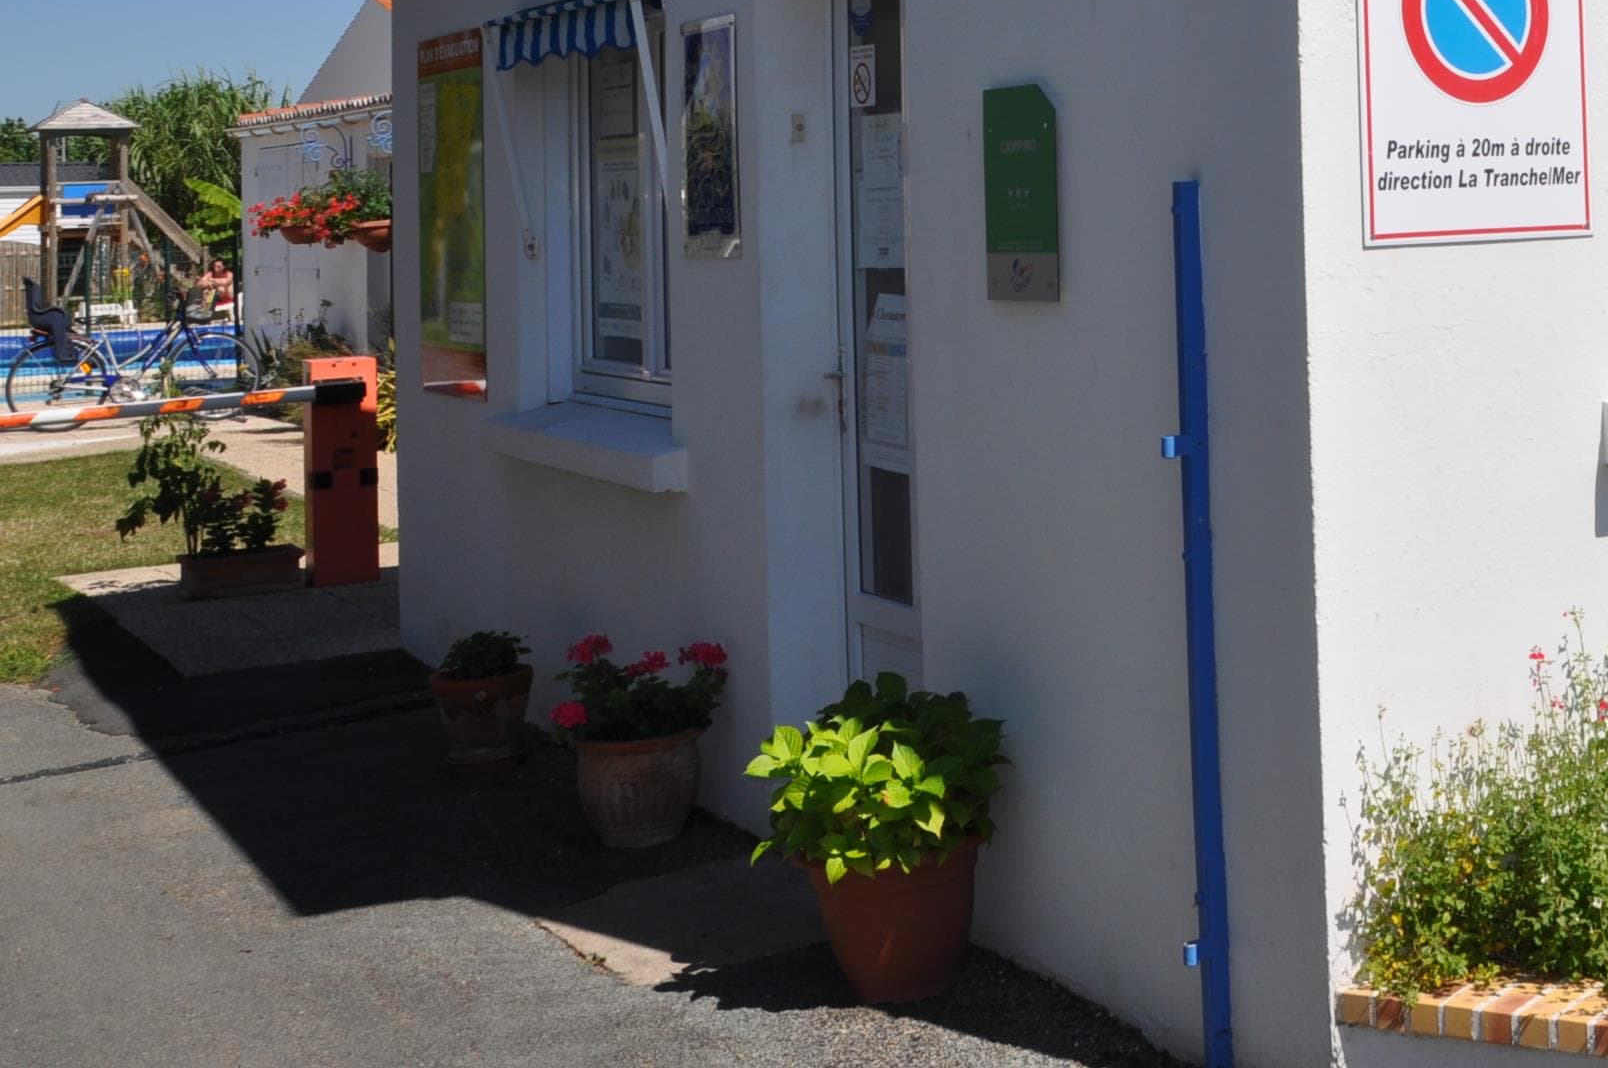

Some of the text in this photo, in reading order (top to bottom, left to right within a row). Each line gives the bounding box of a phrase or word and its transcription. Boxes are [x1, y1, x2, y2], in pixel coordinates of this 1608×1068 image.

[1386, 137, 1571, 163] Parking à 20m à droite
[1377, 170, 1453, 191] direction
[1458, 169, 1478, 188] La
